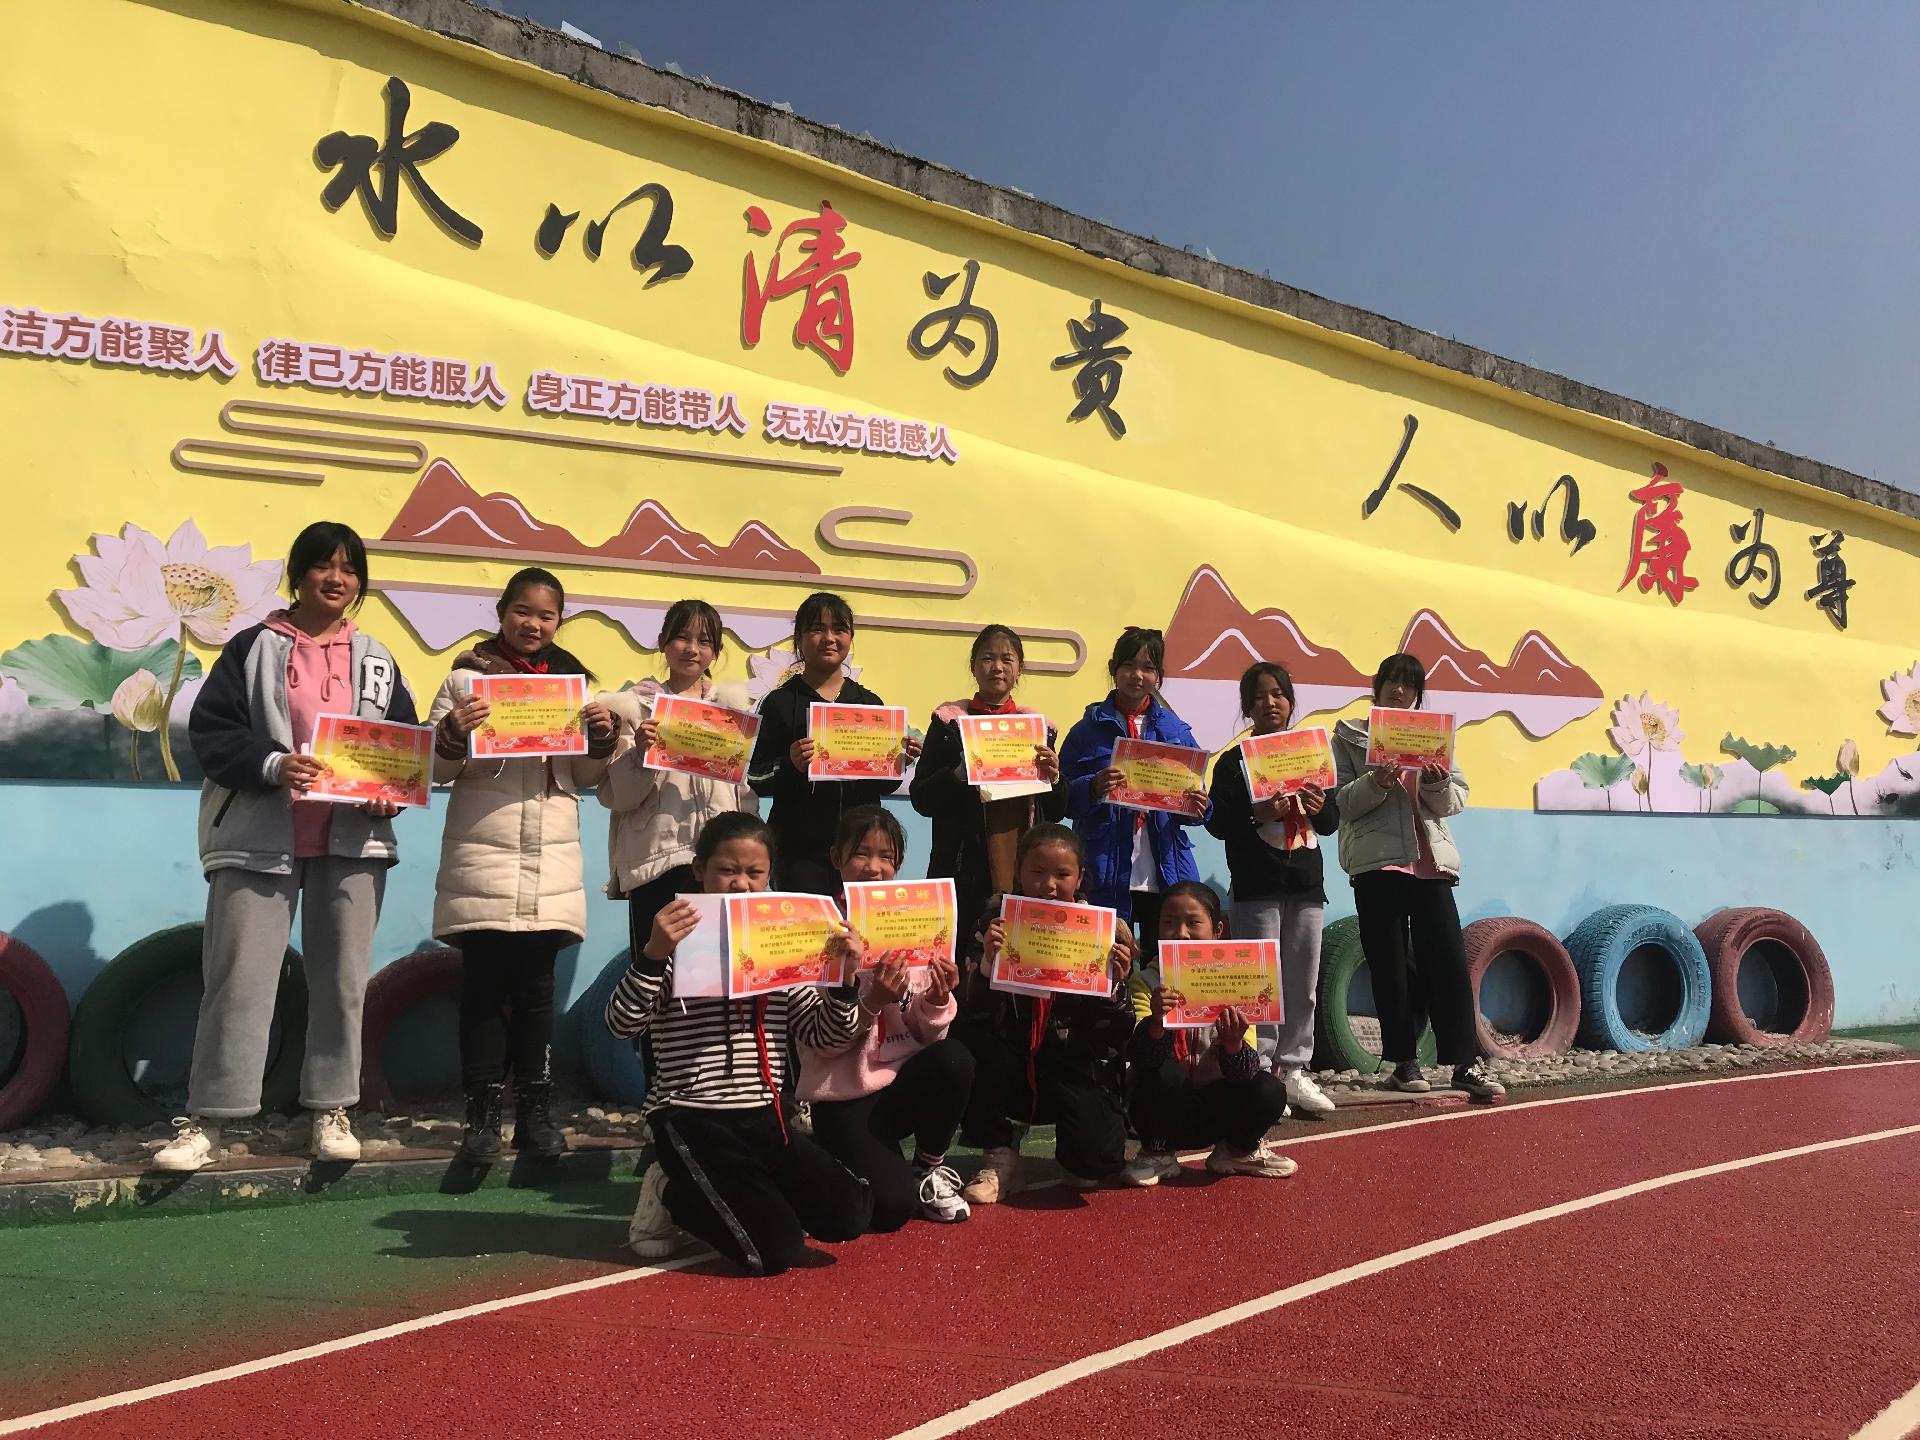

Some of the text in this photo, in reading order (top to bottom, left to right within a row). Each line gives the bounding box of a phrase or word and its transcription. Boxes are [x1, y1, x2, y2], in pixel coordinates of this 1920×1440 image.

[316, 77, 1132, 435] 水以清为贵
[2, 309, 235, 371] 洁方能聚人
[262, 340, 506, 401] 律己方能服人
[532, 373, 747, 429] 身正方能带人
[769, 404, 957, 458] 无私方能感人
[1364, 414, 1856, 630] 人以廉为尊
[361, 655, 392, 711] R
